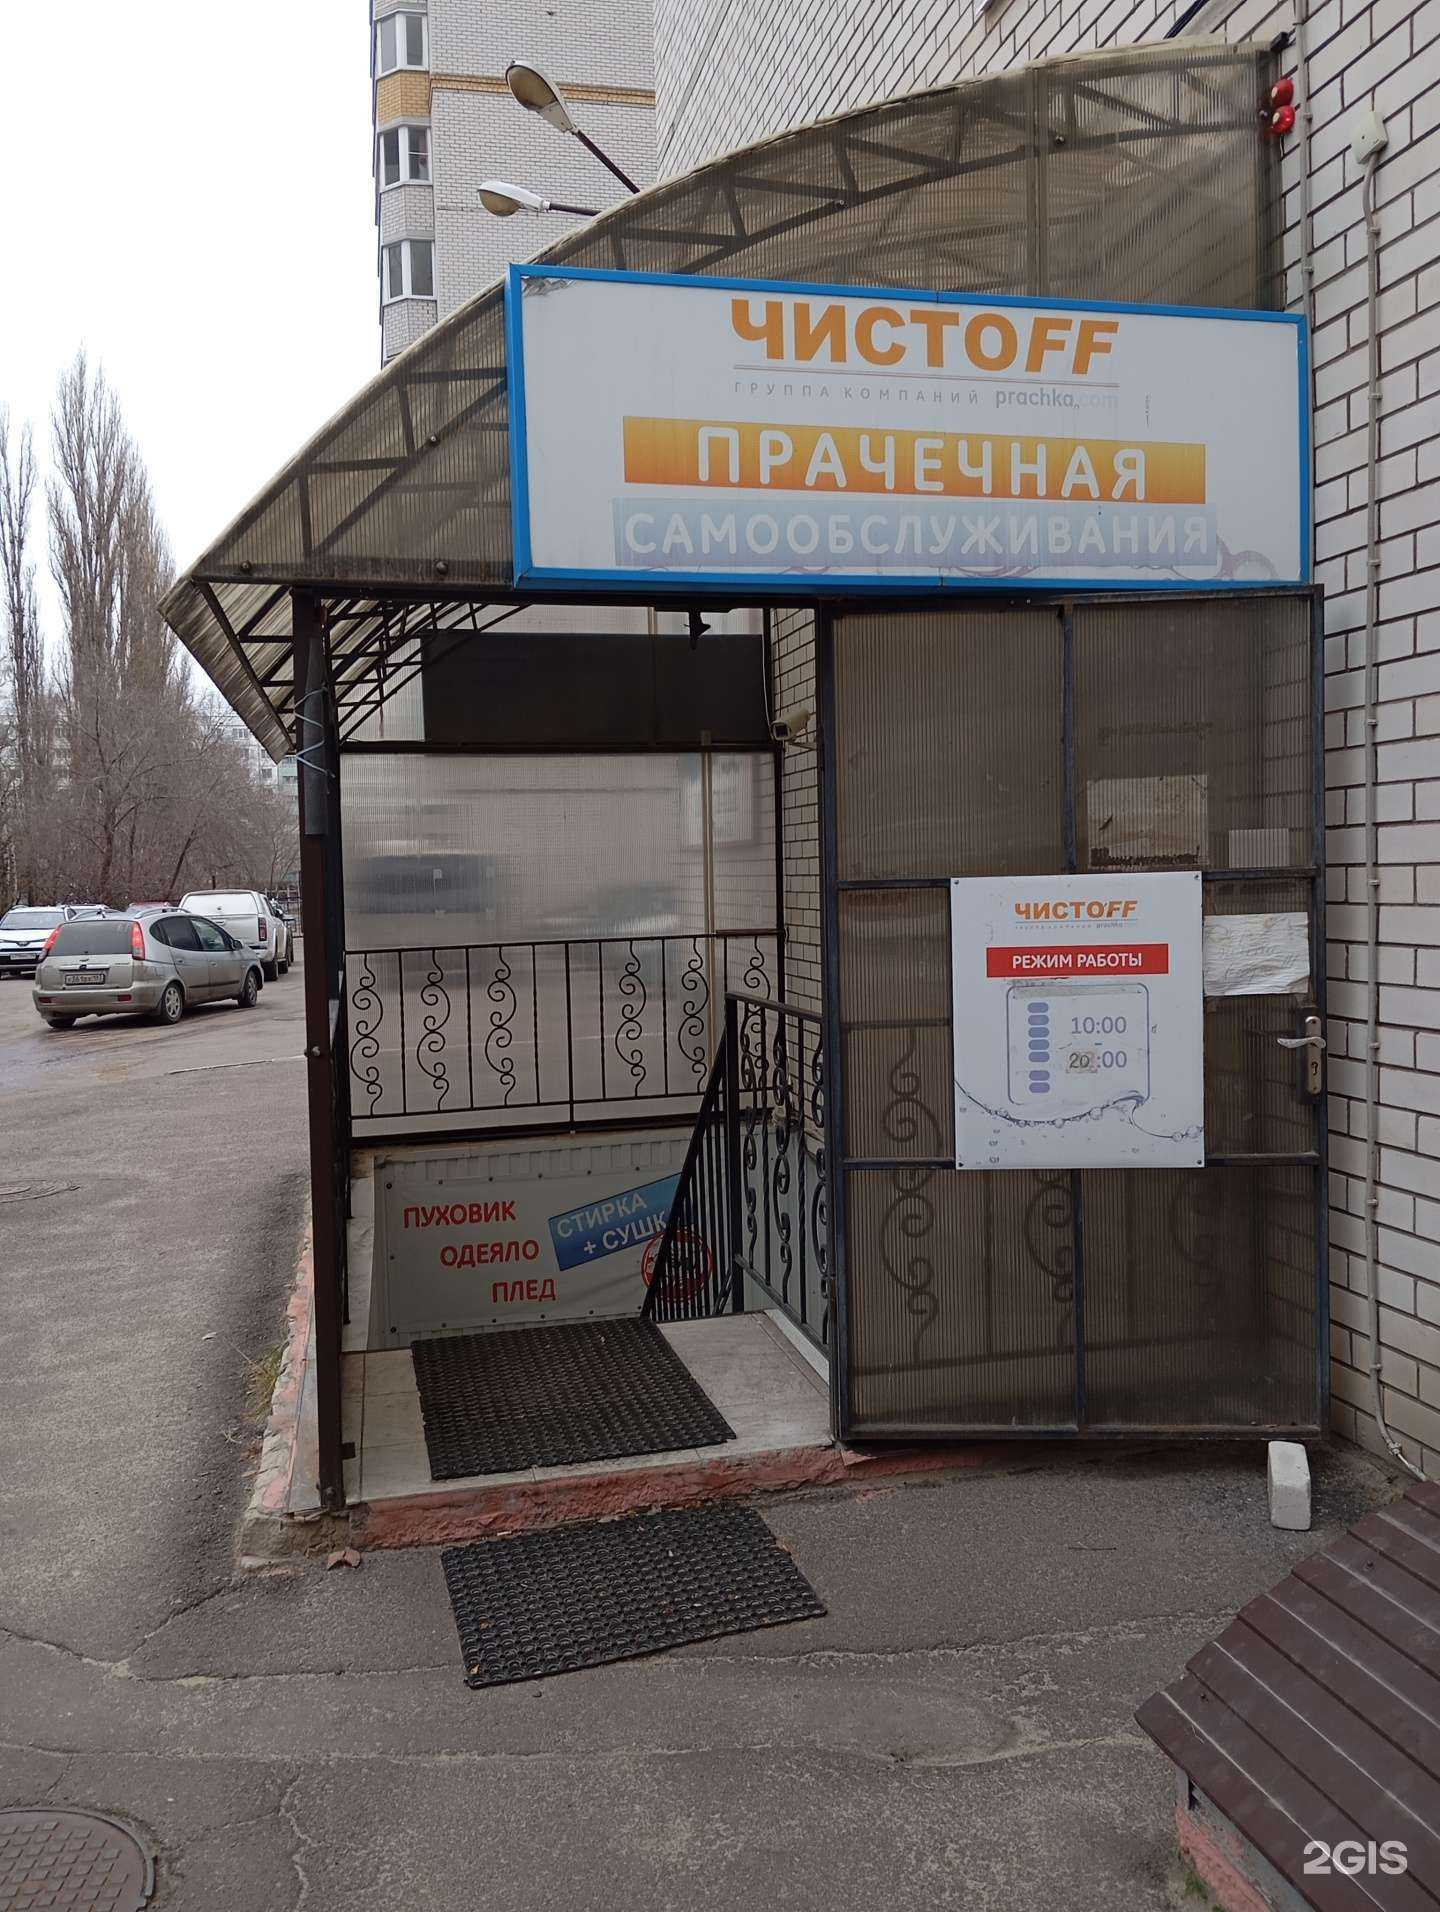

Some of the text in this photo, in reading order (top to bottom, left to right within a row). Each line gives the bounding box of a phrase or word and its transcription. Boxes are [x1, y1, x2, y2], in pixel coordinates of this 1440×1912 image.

[731, 299, 1119, 375] ЧИСТОFF
[734, 382, 830, 399] ГРУППА
[843, 386, 979, 405] КОМПАНИЙ
[697, 426, 1147, 501] ПРАЧЕЧНАЯ
[623, 512, 1209, 556] САМООБСЛУЖИВАНИЯ
[1014, 900, 1138, 920] ЧИСТОFF
[1012, 953, 1142, 969] РЕЖИМ РАБОТЫ
[1071, 1016, 1128, 1034] 10:00
[404, 1201, 516, 1229] ПУХОВИК
[556, 1192, 648, 1239] СТИРКА
[602, 1207, 670, 1250] СУШК
[440, 1240, 539, 1268] ОДЕЯЛО
[492, 1278, 557, 1303] ПЛЕД
